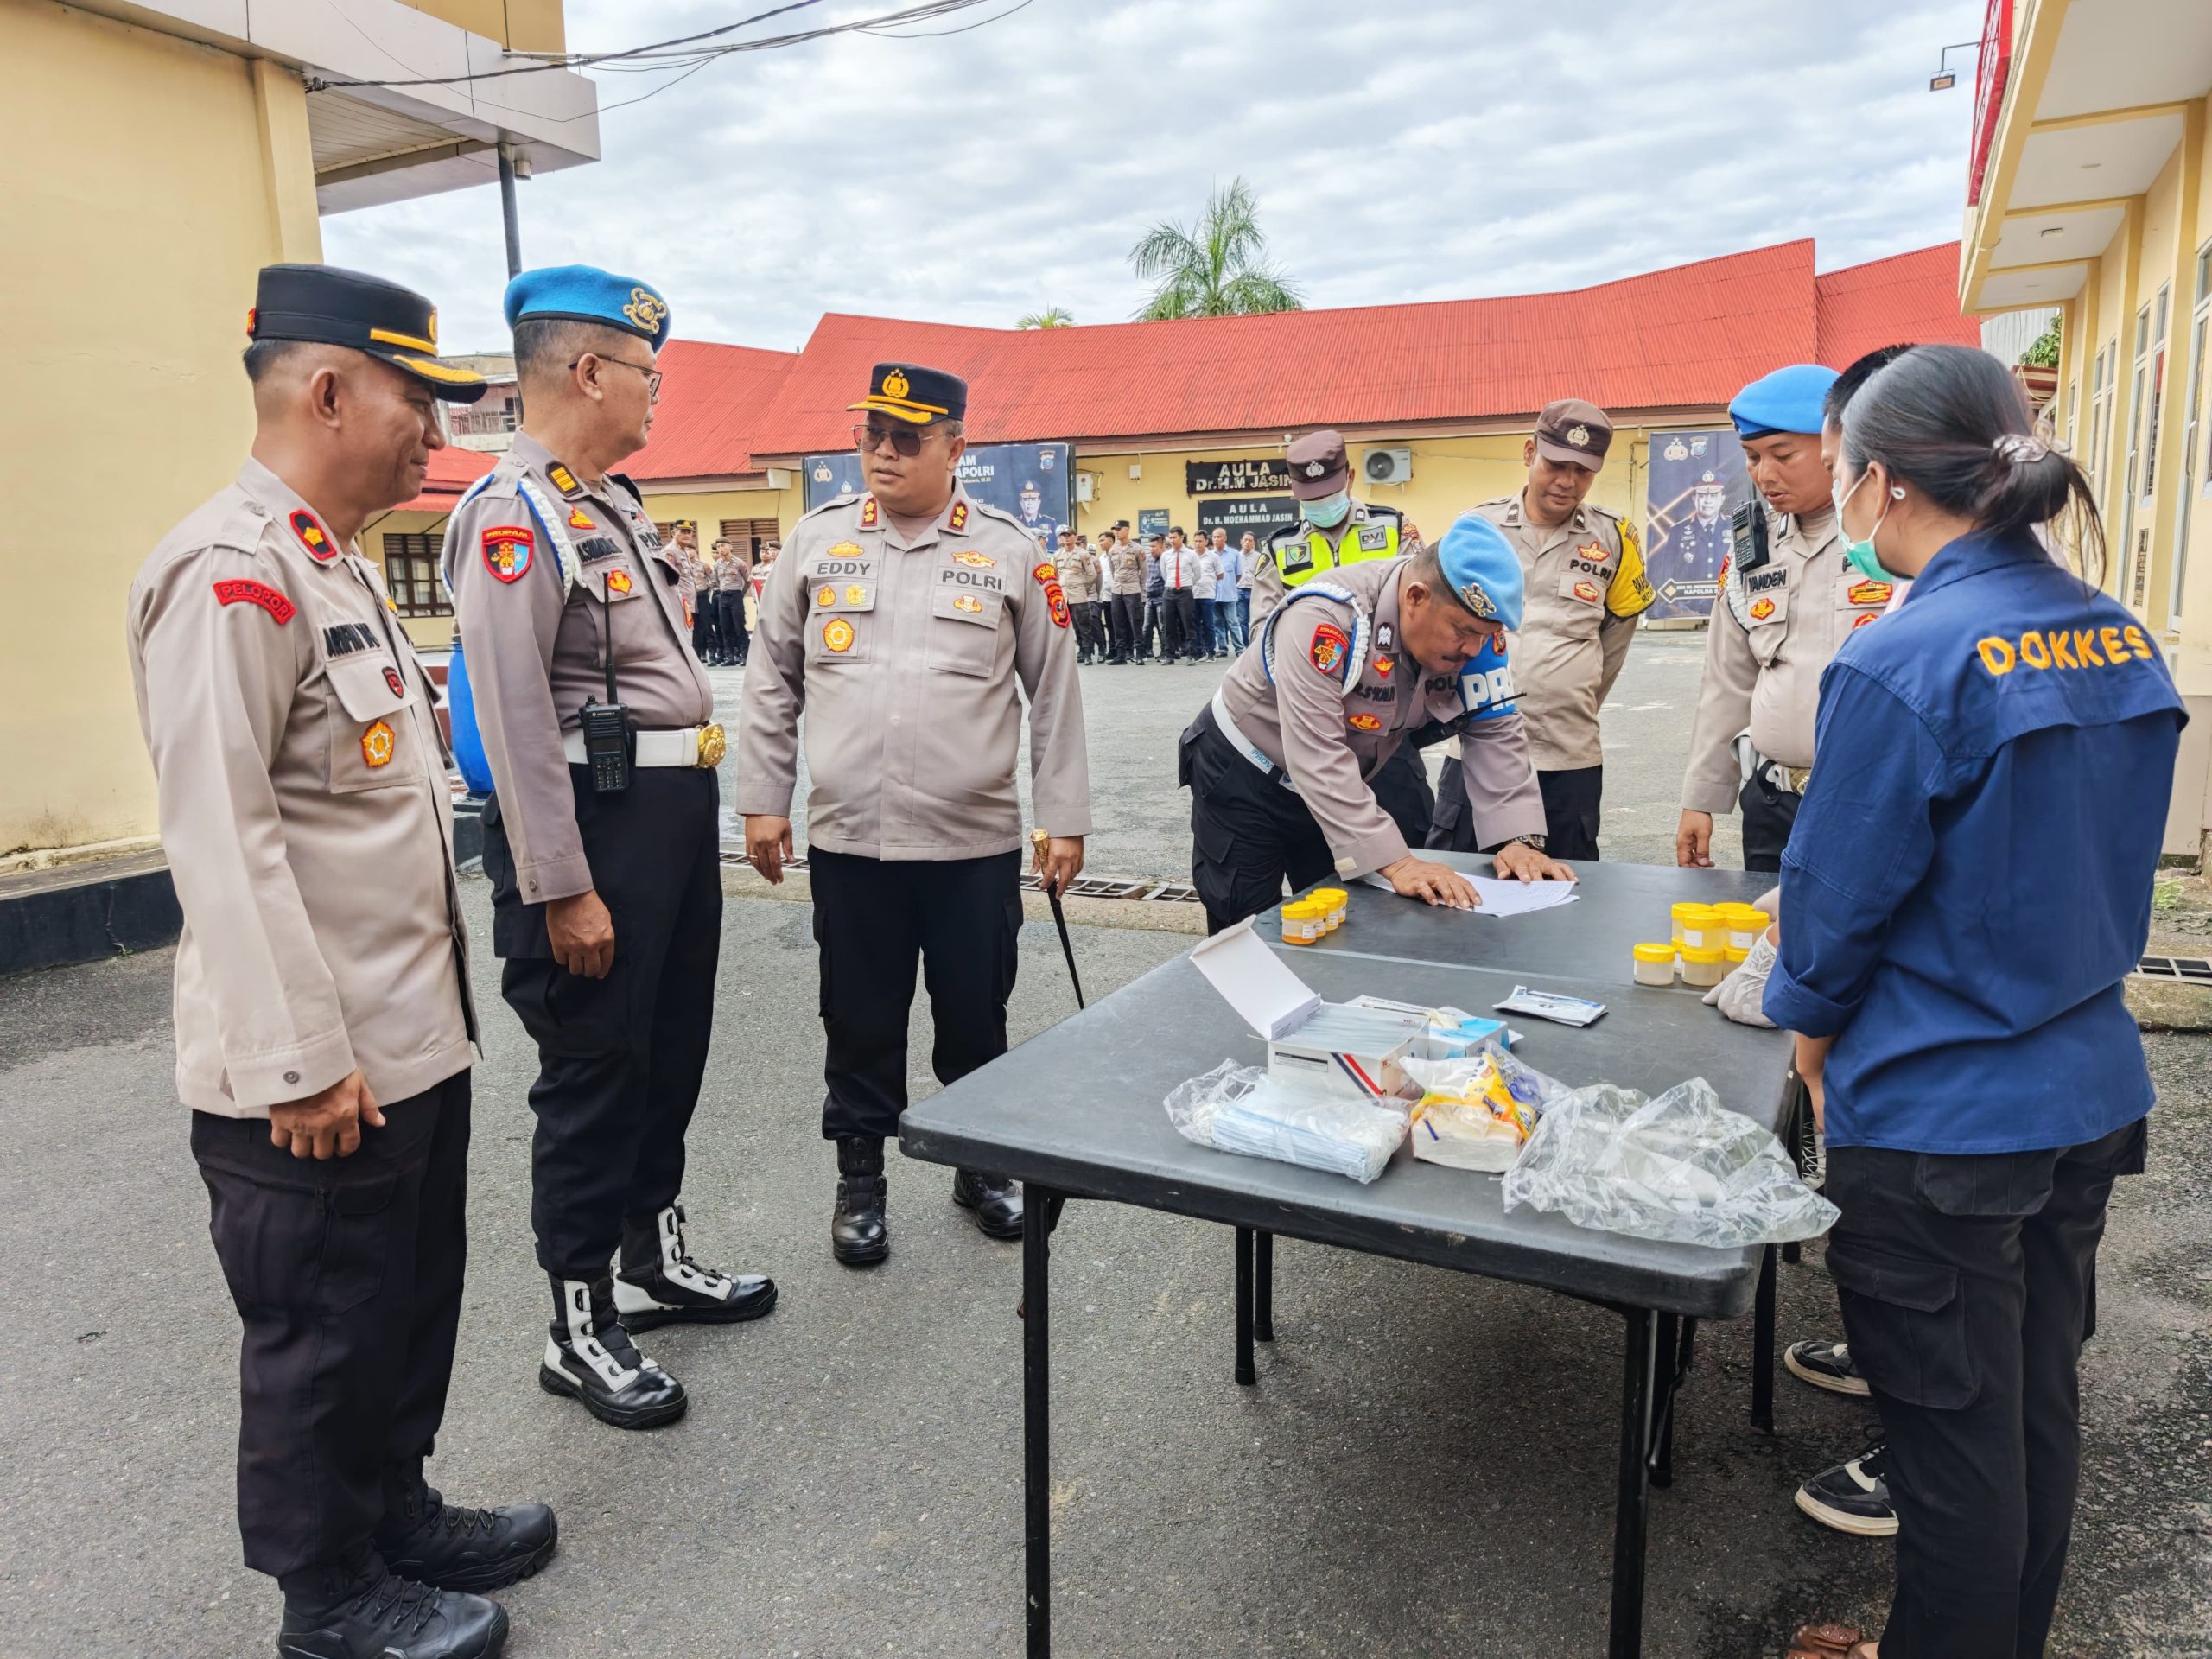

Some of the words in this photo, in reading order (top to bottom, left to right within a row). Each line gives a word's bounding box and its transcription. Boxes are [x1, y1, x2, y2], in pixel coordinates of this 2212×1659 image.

[955, 465, 995, 477] APOLRI
[1219, 462, 1270, 477] AULA
[1229, 504, 1267, 513] AULA
[1224, 514, 1270, 524] MOEHAMMAD
[1272, 513, 1293, 522] JASIN
[486, 530, 527, 538] PROPAM
[817, 563, 871, 576] EDDY
[1570, 559, 1611, 581] POLRI
[942, 570, 1002, 591] POLRI
[221, 583, 289, 617] PELOPOR
[1976, 625, 2153, 677] DOKKES
[1425, 676, 1458, 696] POL
